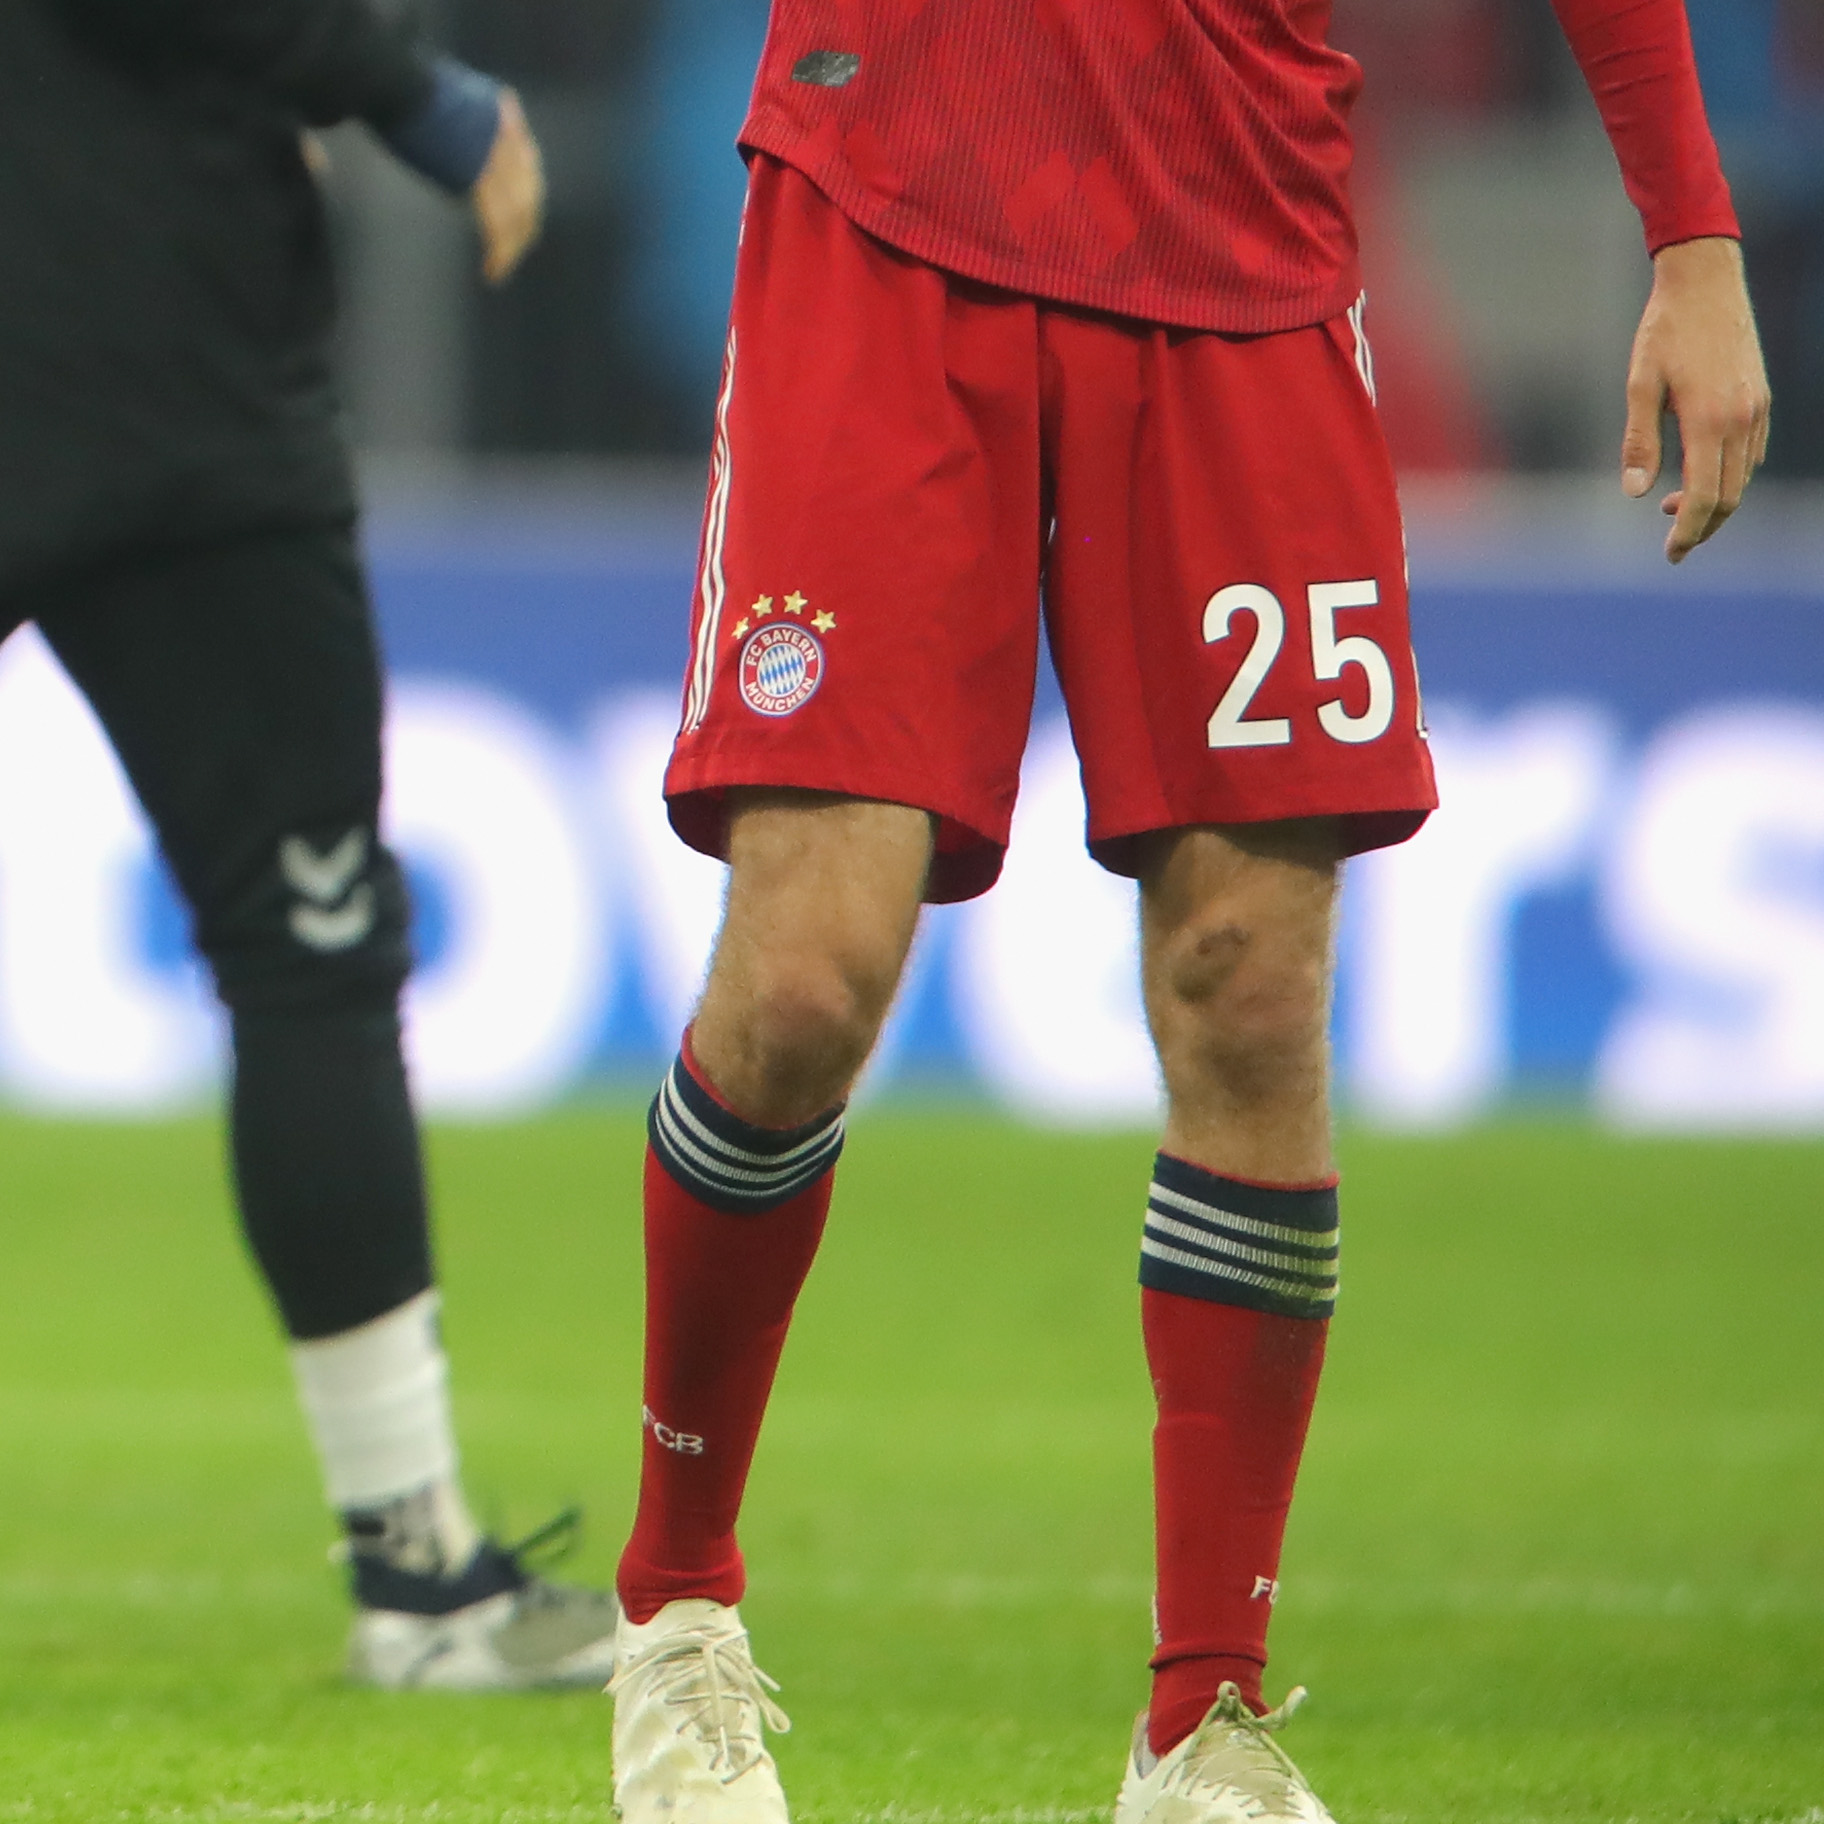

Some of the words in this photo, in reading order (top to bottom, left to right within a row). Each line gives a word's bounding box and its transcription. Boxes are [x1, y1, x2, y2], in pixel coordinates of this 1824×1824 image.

[745, 644, 762, 667] FC
[759, 628, 817, 663] BAYERN
[1202, 578, 1395, 748] 25
